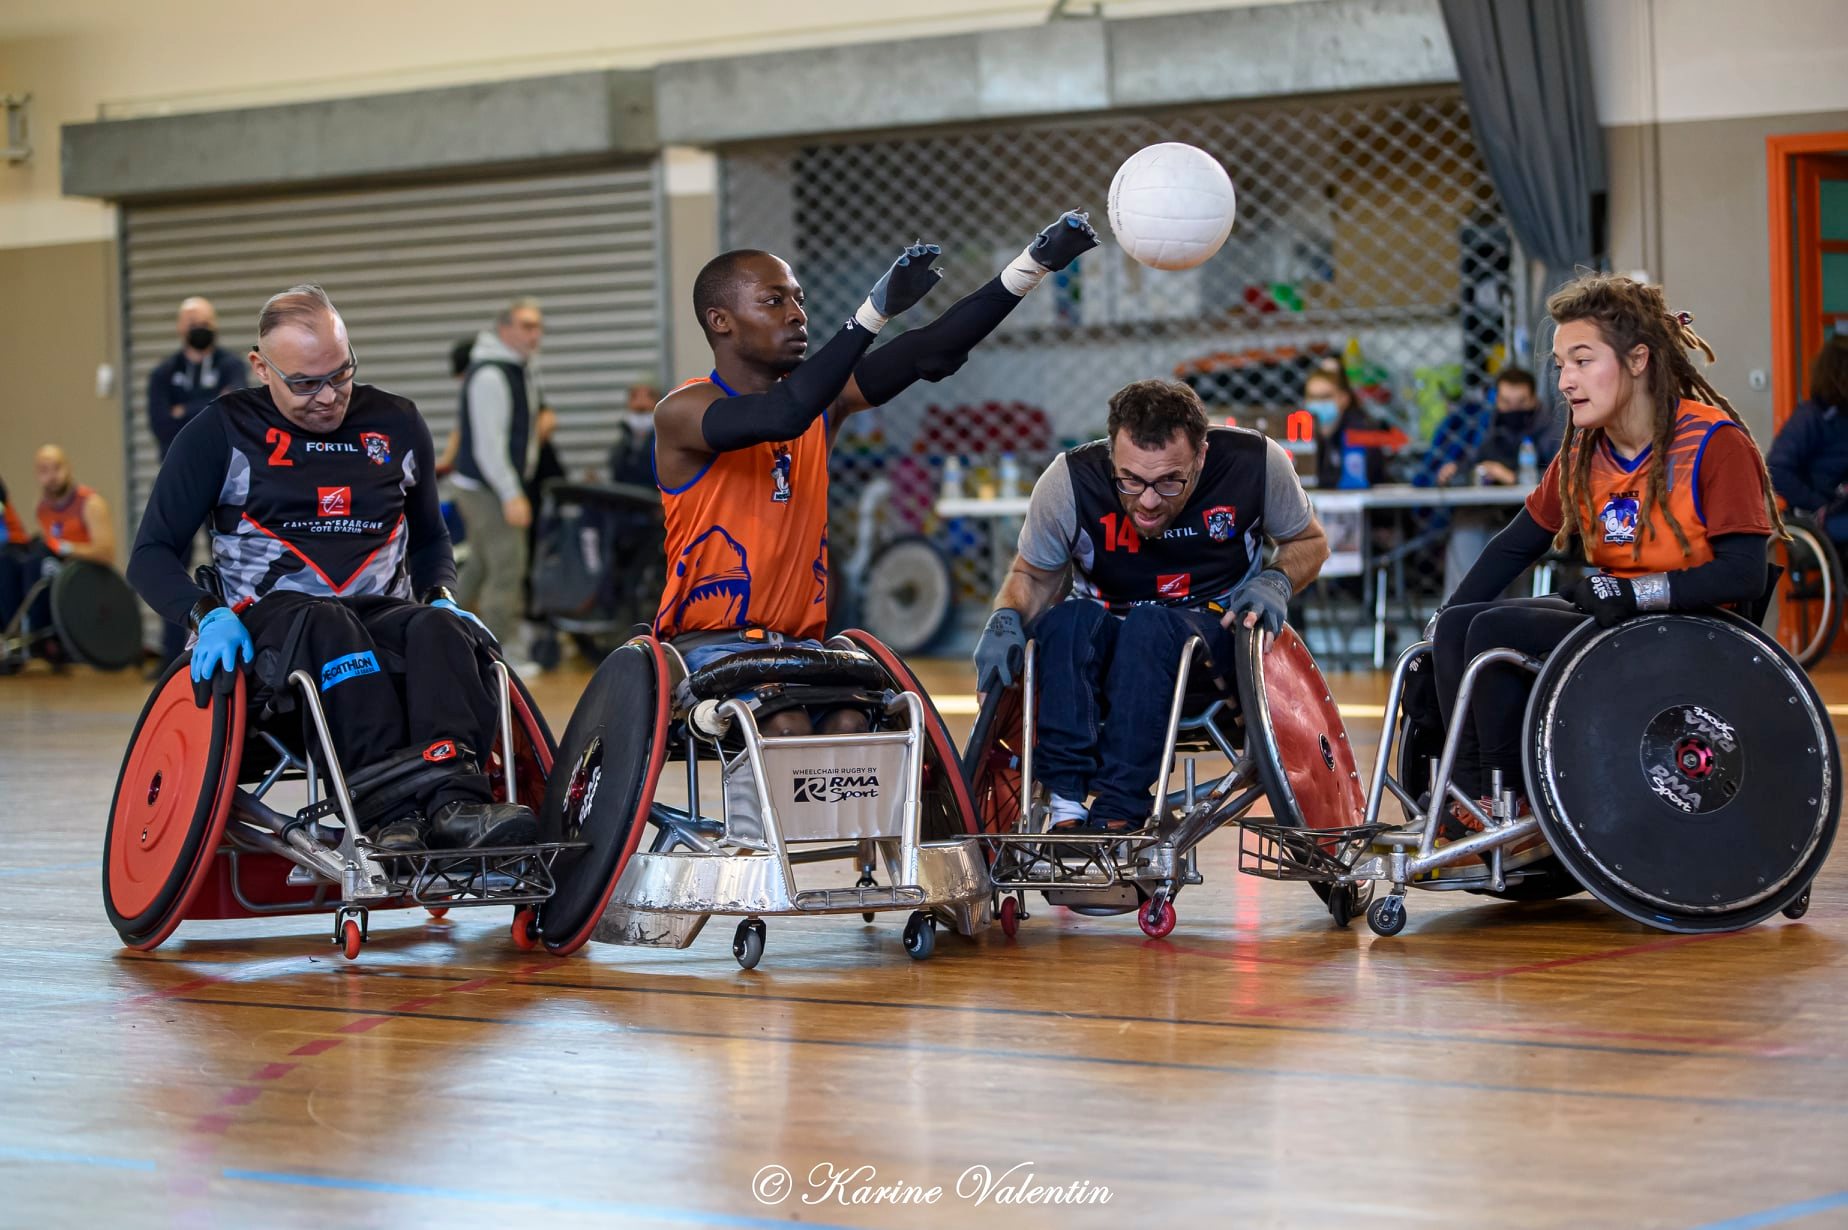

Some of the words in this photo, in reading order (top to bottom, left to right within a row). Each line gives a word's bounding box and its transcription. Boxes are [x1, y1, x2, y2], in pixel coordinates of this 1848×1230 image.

[265, 427, 294, 466] 2
[306, 442, 359, 452] FORTIL
[1099, 512, 1139, 553] 14
[1145, 526, 1199, 540] RTIL
[829, 776, 880, 788] RMA
[829, 787, 879, 803] Sport
[1647, 764, 1702, 809] RMA
[1651, 776, 1692, 812] Sport
